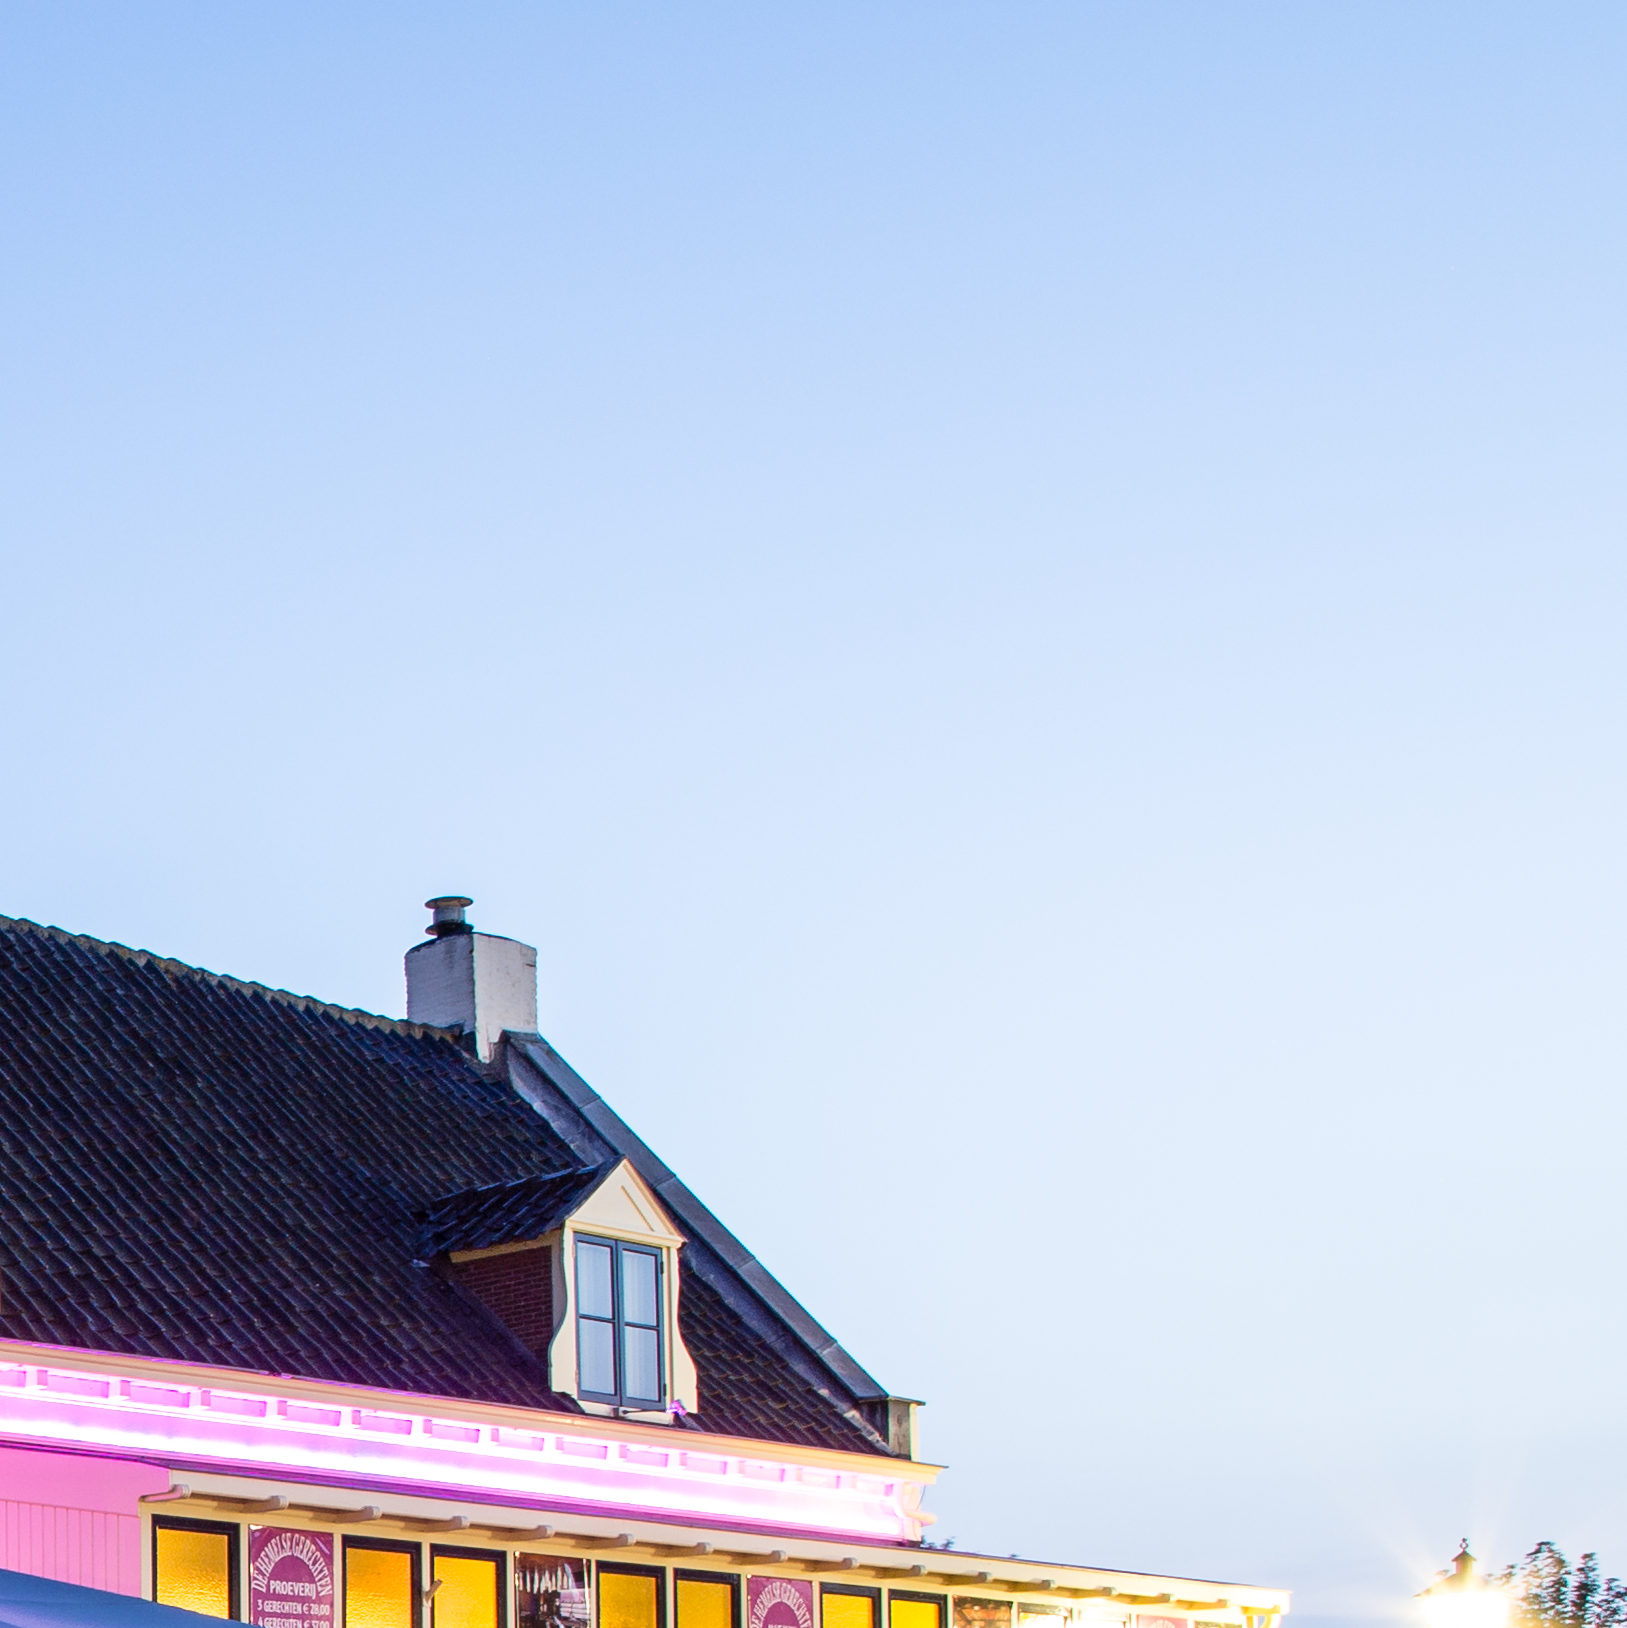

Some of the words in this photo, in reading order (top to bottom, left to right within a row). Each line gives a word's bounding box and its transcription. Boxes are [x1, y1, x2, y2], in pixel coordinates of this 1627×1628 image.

[255, 1532, 292, 1579] HEMELSE
[291, 1533, 333, 1597] GERECHTEN
[251, 1570, 268, 1594] DE
[269, 1580, 317, 1600] PROEVERIJ
[257, 1599, 263, 1611] 3
[263, 1600, 302, 1615] GERECHTEN
[310, 1603, 330, 1616] 28,00
